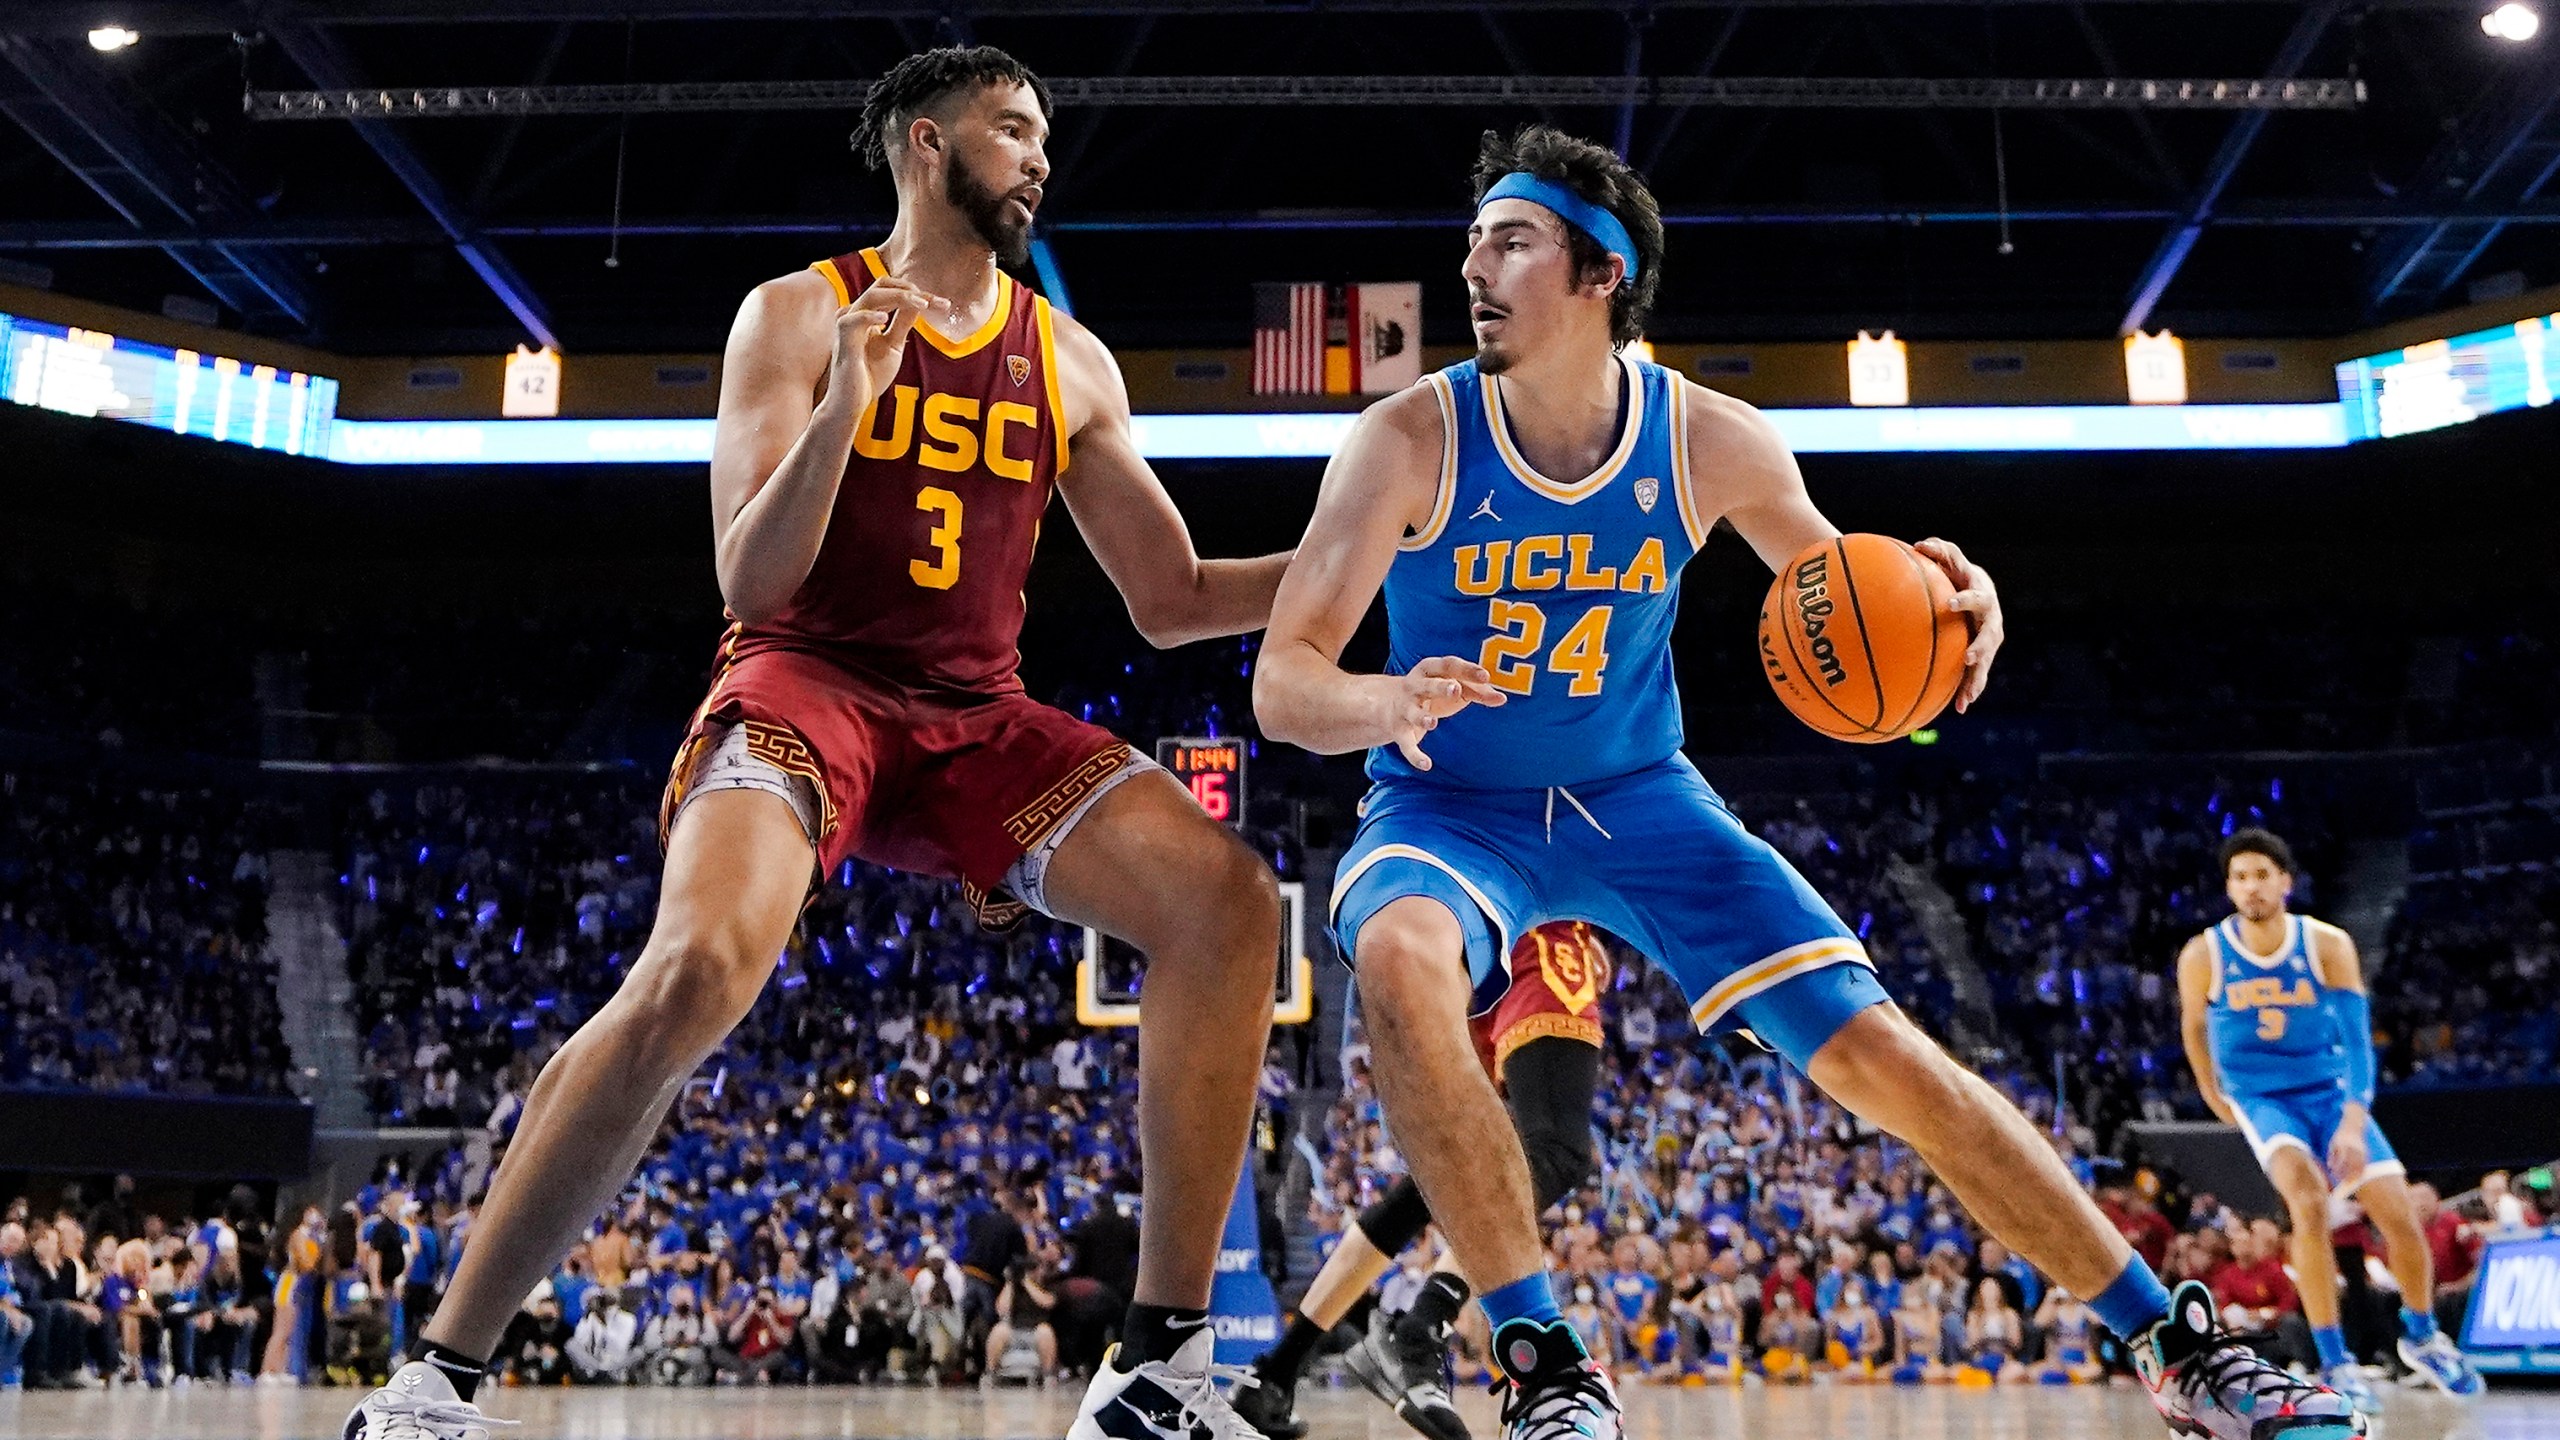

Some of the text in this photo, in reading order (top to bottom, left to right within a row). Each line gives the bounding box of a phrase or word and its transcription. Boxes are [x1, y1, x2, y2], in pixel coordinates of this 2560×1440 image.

[519, 377, 545, 395] 42
[853, 385, 1037, 483] USC
[909, 486, 963, 590] 3
[1454, 534, 1667, 596] UCLA
[1479, 598, 1613, 697] 24
[1796, 551, 1847, 688] Wilson
[1175, 747, 1237, 771] 11:44
[1191, 772, 1229, 821] 16
[2225, 976, 2318, 1012] UCLA
